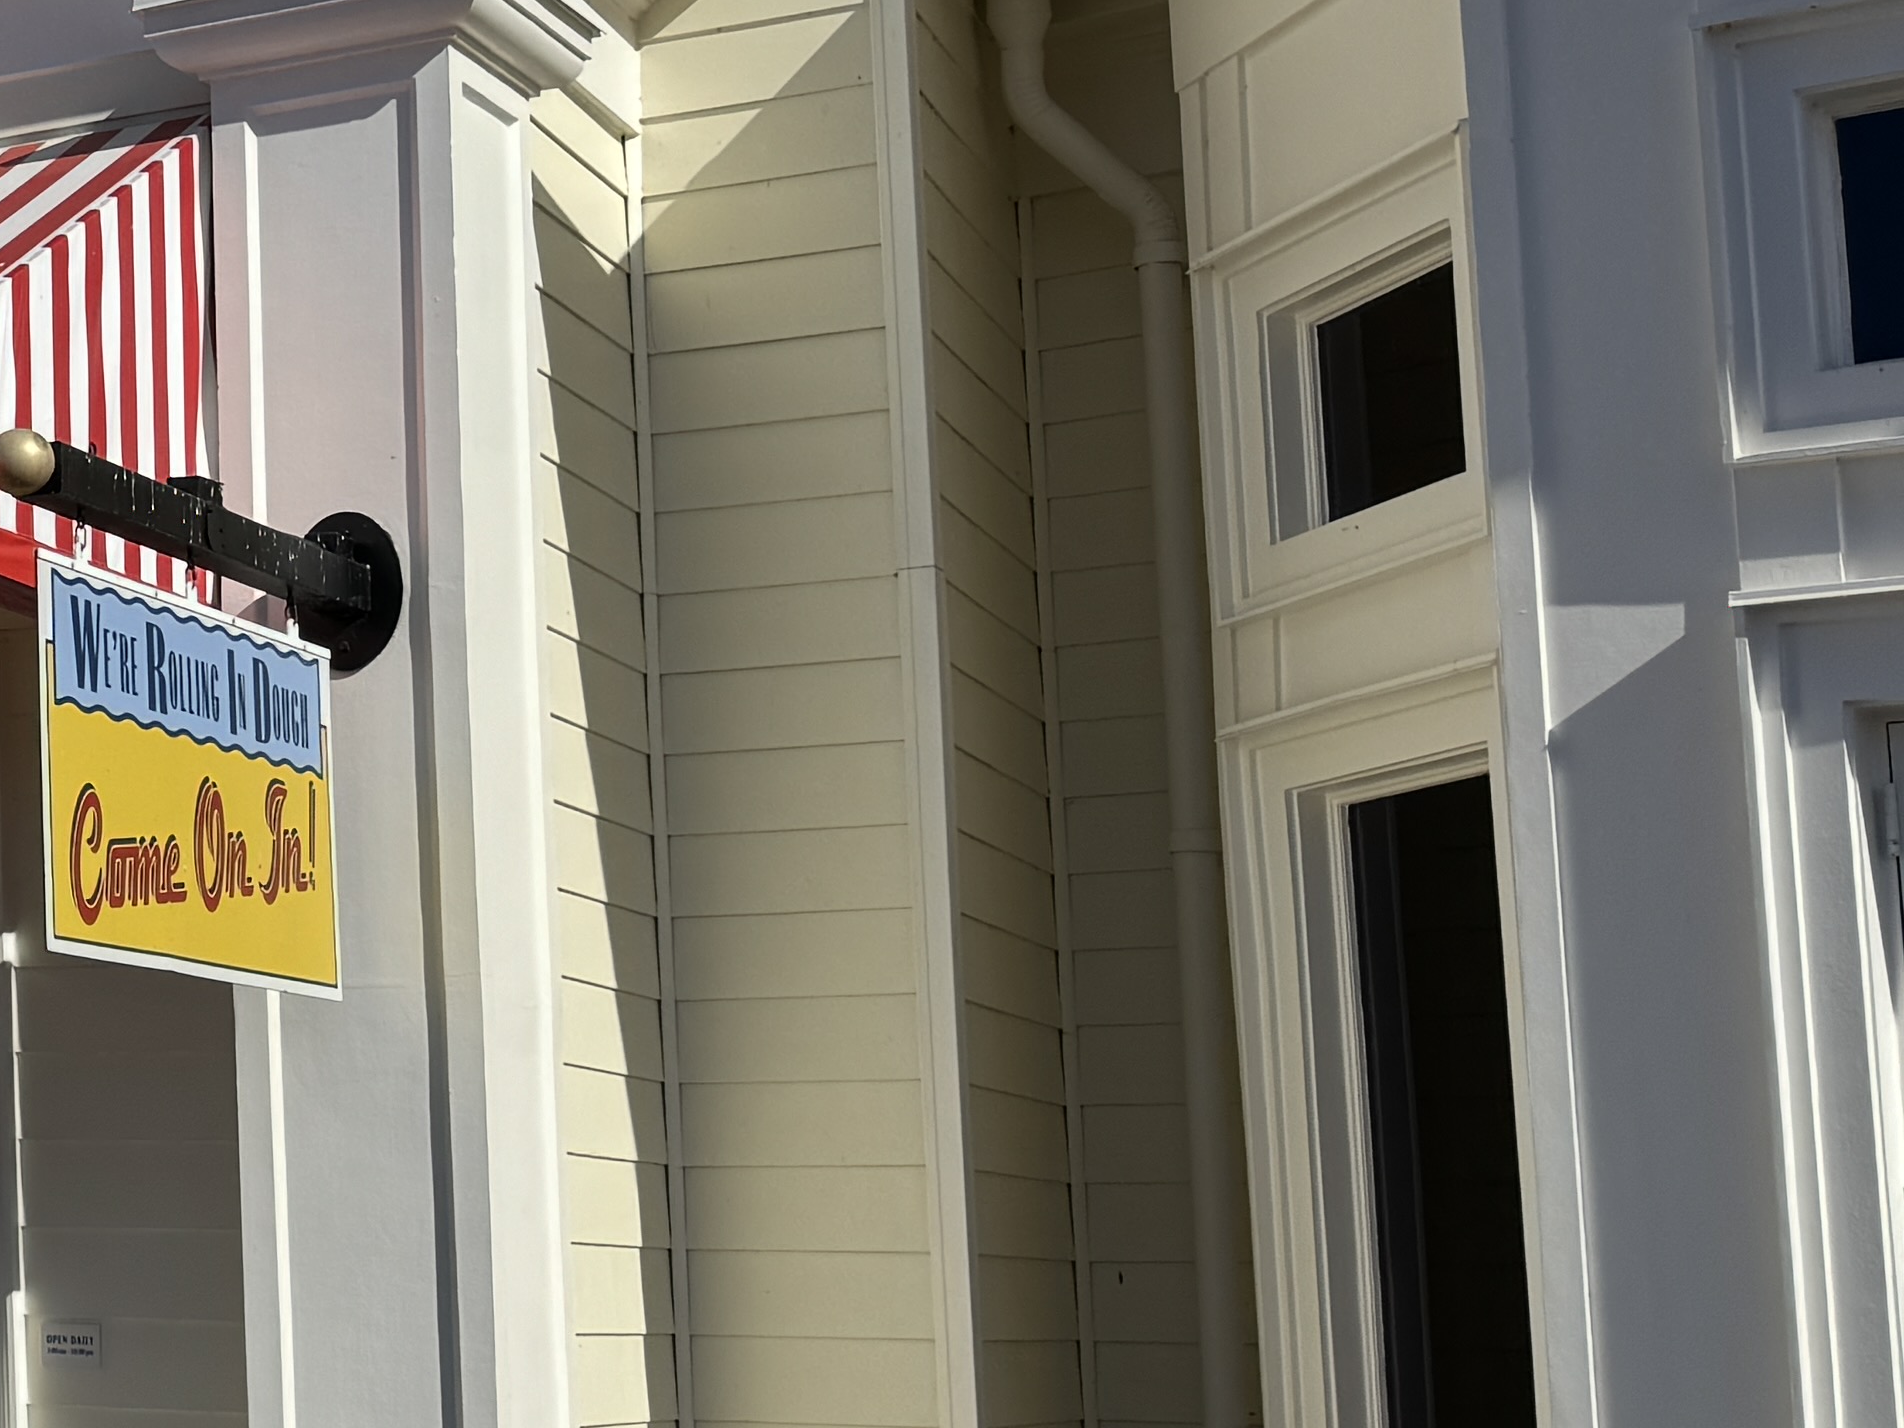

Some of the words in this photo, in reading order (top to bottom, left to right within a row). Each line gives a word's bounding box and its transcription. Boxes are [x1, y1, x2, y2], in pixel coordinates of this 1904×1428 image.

[70, 595, 139, 697] WE'RE
[145, 621, 221, 723] ROLLING
[227, 649, 248, 736] IN
[252, 656, 310, 750] DOUGH
[69, 782, 188, 926] Come
[194, 776, 254, 913] On
[260, 778, 316, 905] In!
[47, 1334, 68, 1344] OPEN
